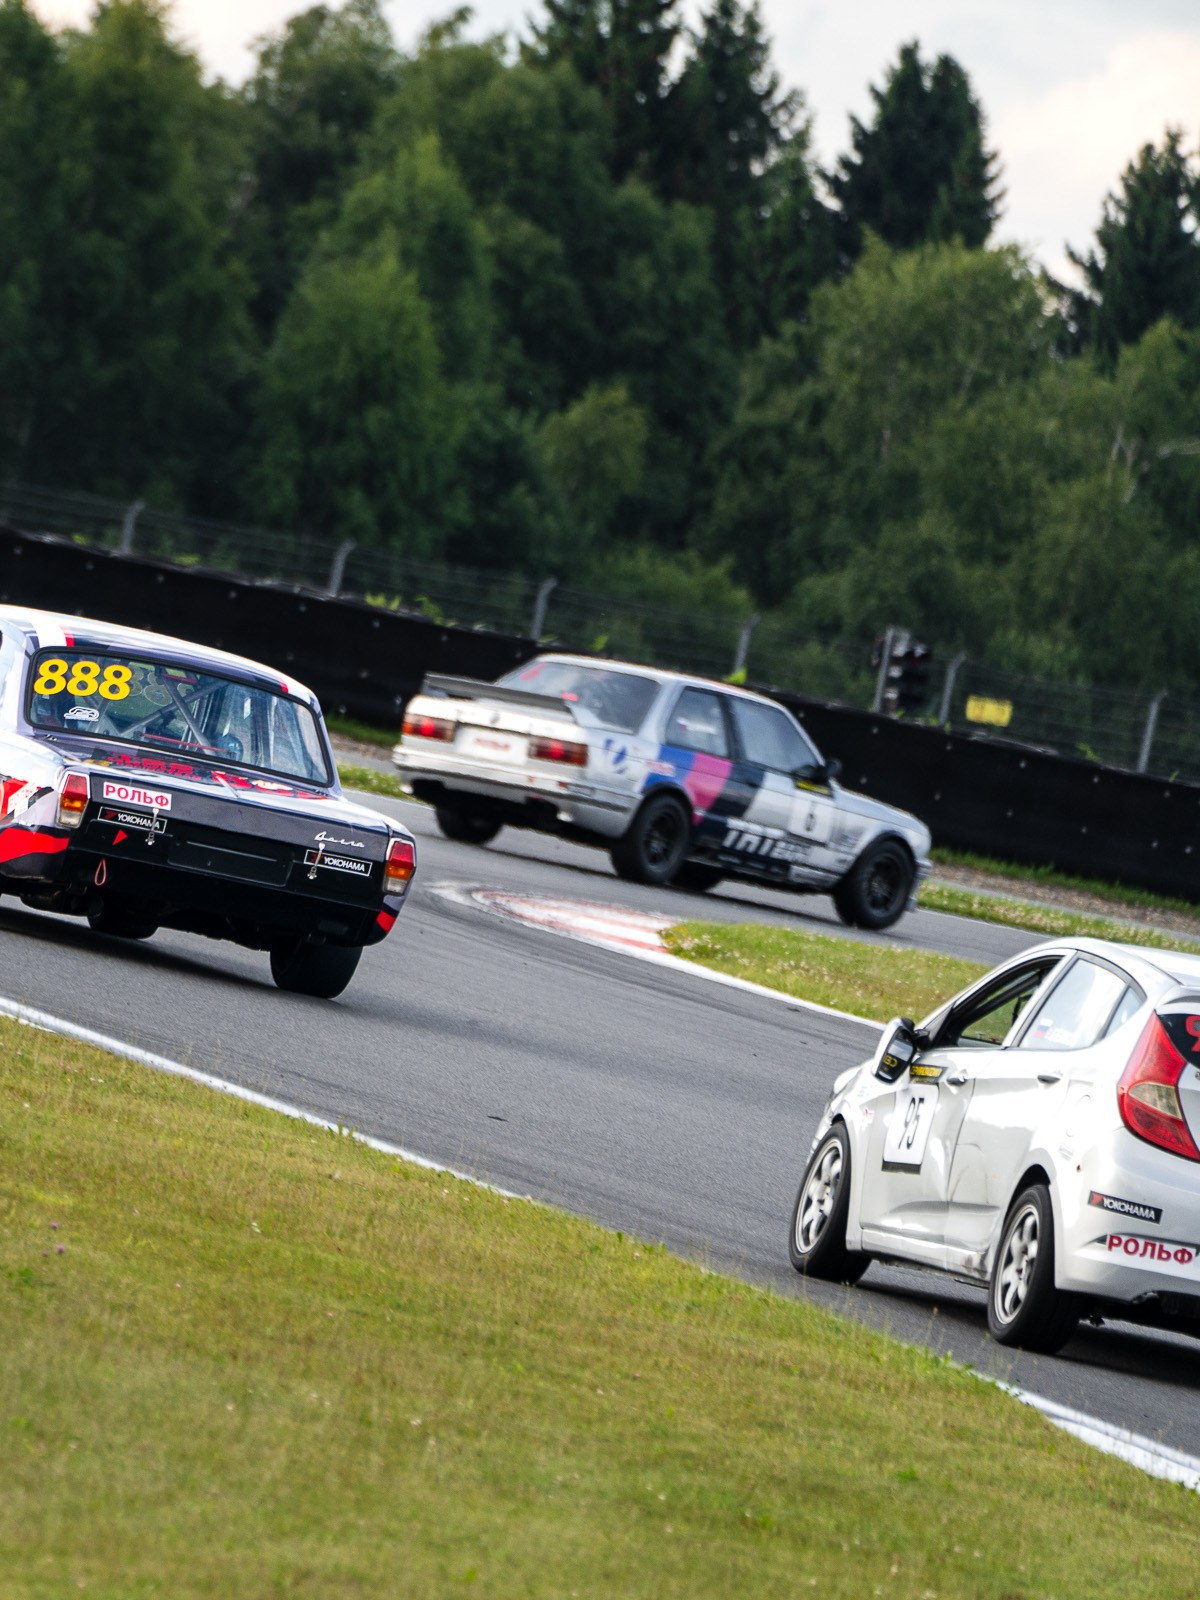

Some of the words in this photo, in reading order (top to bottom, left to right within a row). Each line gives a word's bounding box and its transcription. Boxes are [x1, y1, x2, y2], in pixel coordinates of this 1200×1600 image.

[33, 658, 133, 701] 888
[104, 784, 170, 808] РОЛЬФ
[117, 812, 161, 830] YOKOHAMA
[324, 856, 366, 872] YOKOHAMA
[898, 1096, 925, 1150] 95
[1103, 1196, 1156, 1220] YOKOHAMA
[1107, 1233, 1193, 1265] РОЛЬФ
